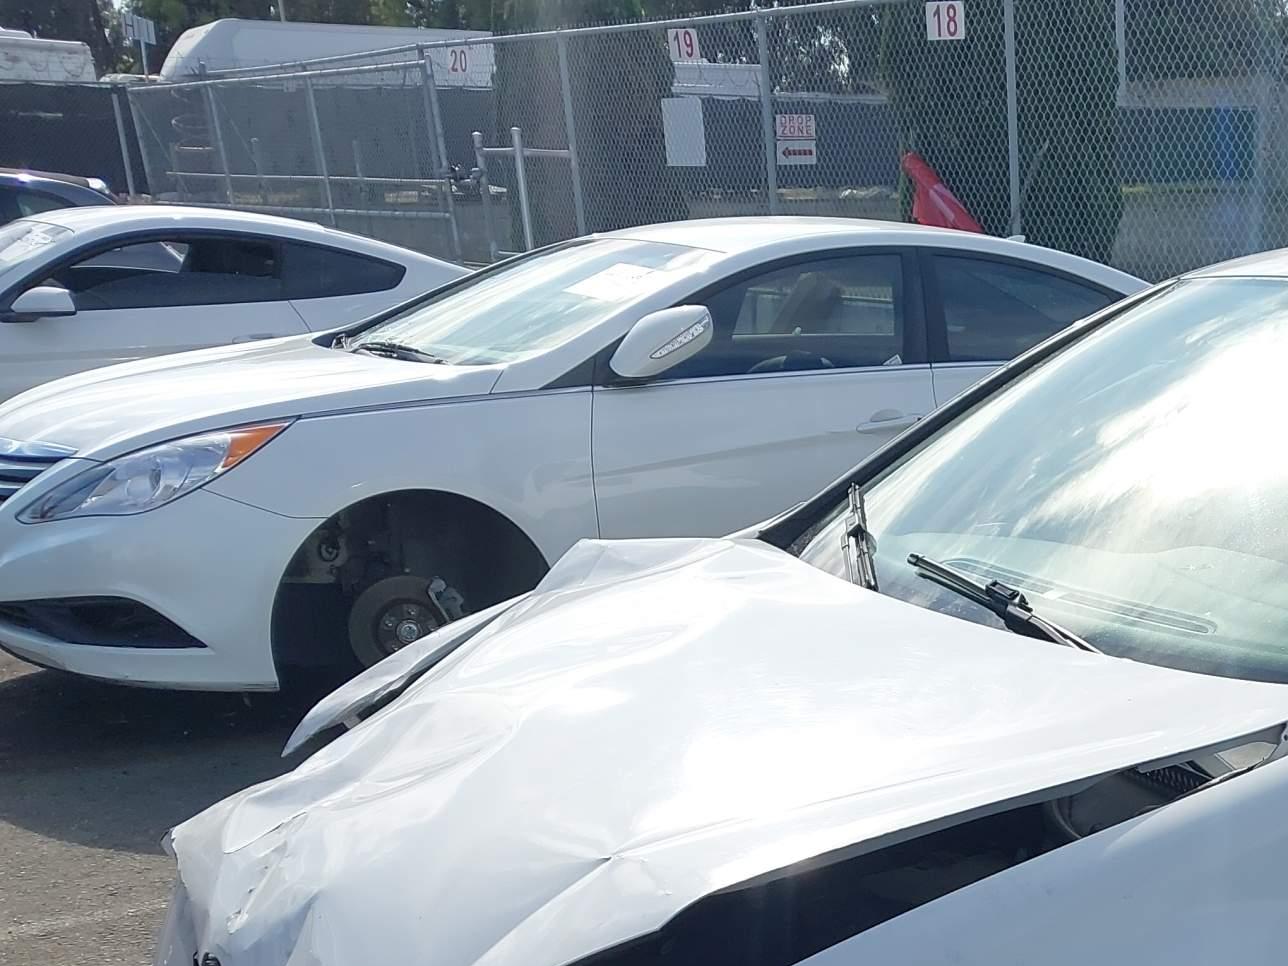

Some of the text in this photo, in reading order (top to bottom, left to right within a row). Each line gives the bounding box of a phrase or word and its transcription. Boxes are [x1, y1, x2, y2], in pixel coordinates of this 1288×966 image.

[932, 3, 958, 38] 18
[673, 30, 694, 58] 19
[449, 49, 468, 73] 20
[780, 115, 812, 125] DROP
[781, 125, 812, 136] ZONE
